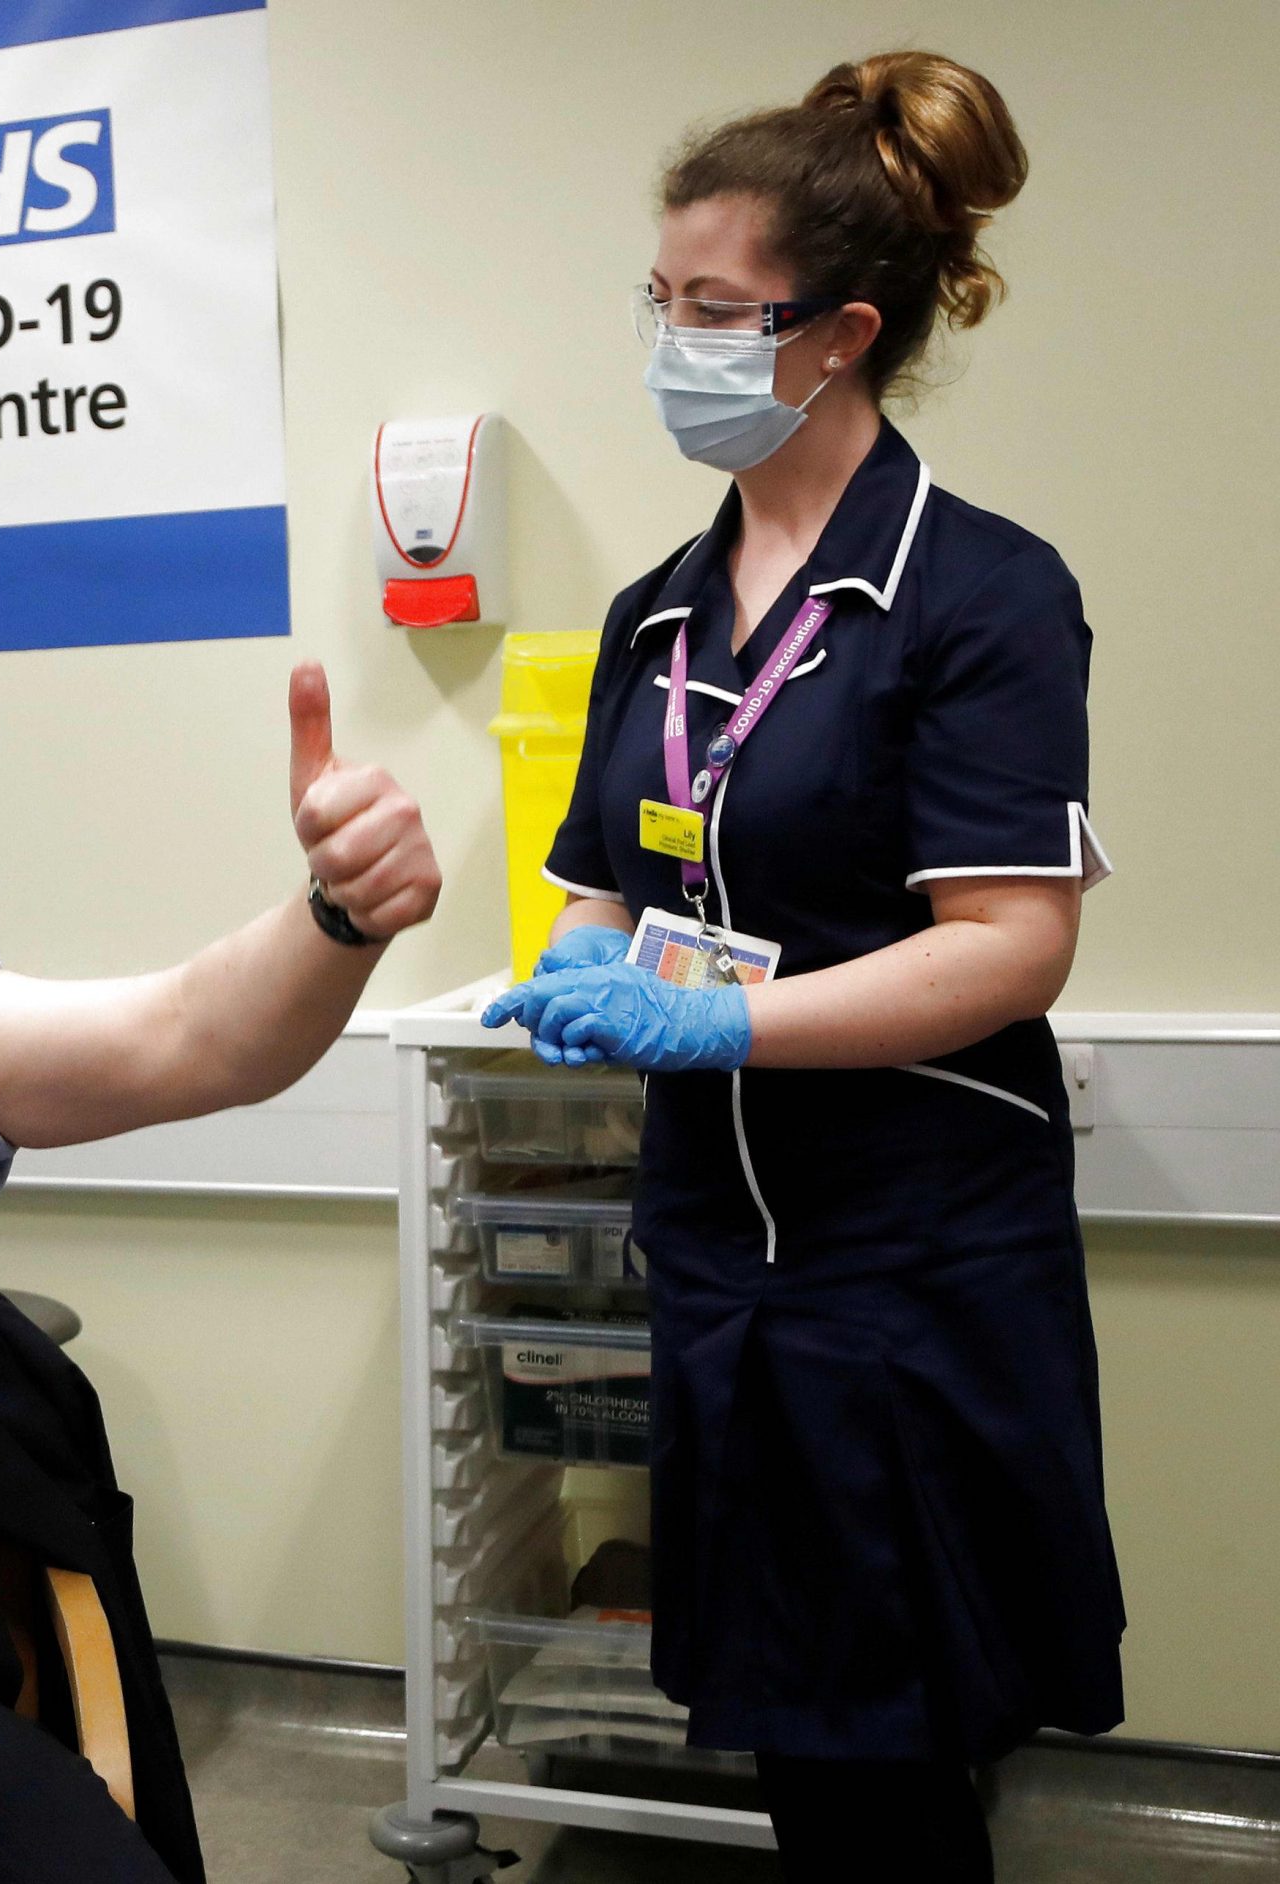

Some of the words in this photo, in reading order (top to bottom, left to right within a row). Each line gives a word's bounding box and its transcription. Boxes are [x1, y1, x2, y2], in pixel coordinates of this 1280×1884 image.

[733, 679, 774, 735] COVID-19
[770, 612, 820, 679] vaccination
[555, 1403, 568, 1415] IN
[601, 1410, 650, 1423] ALCOH
